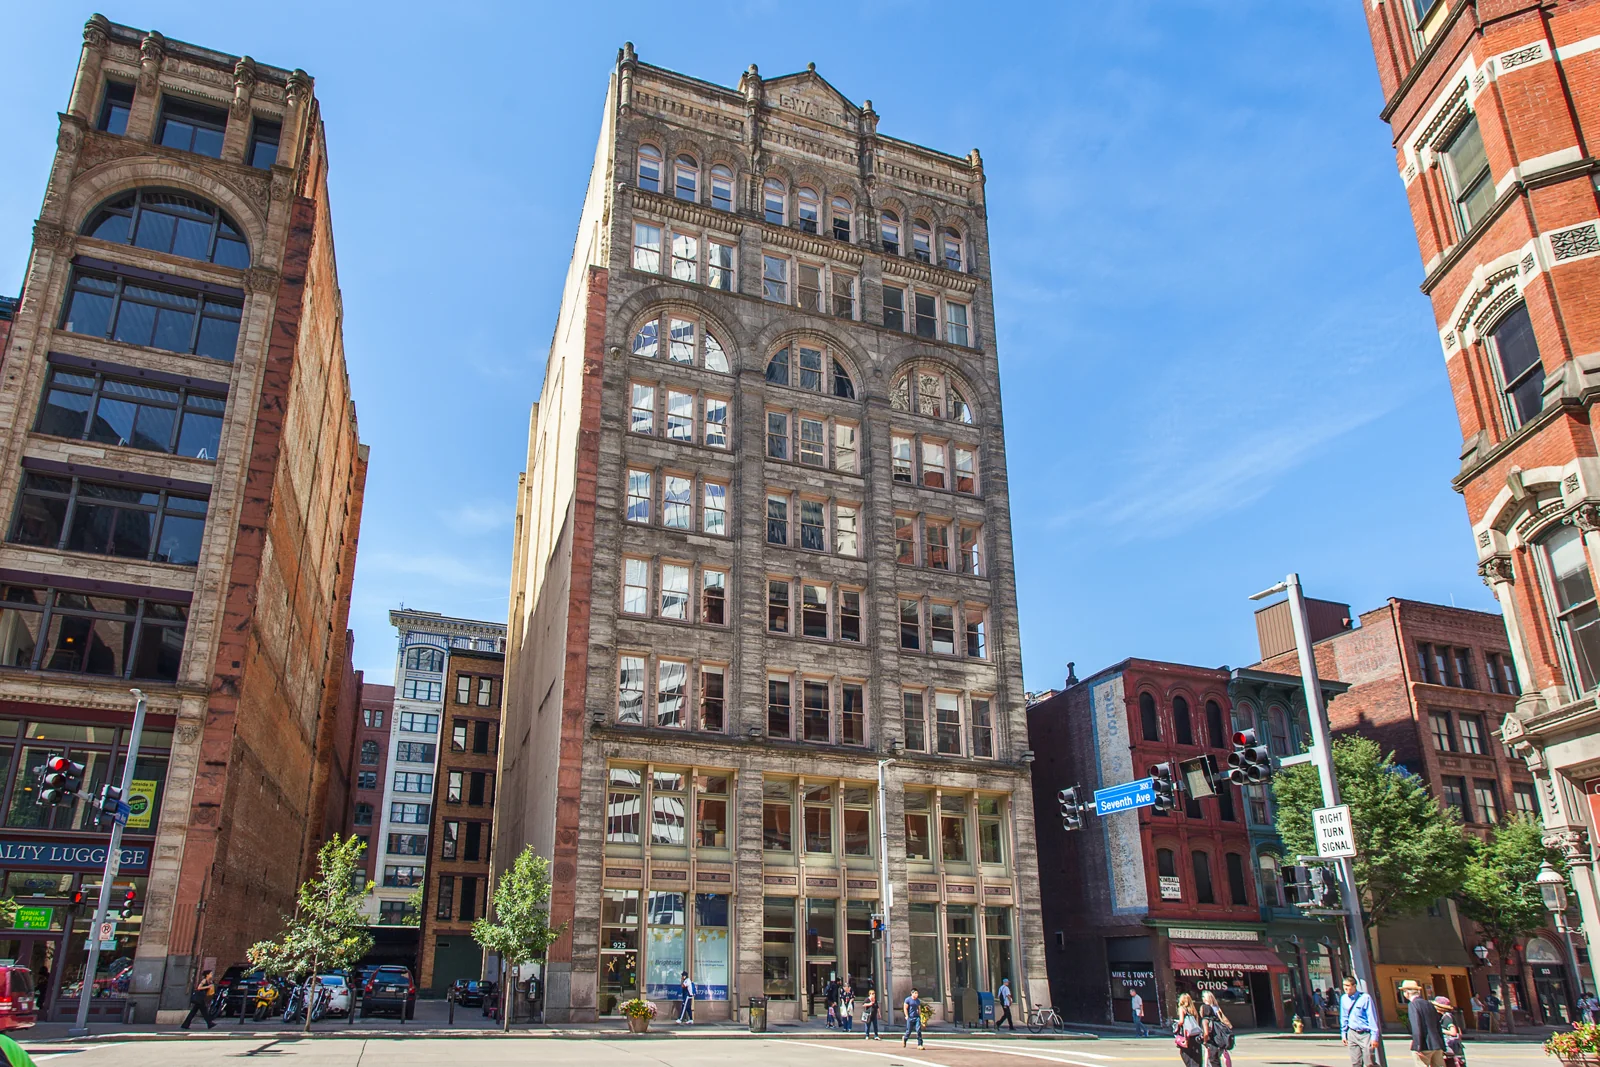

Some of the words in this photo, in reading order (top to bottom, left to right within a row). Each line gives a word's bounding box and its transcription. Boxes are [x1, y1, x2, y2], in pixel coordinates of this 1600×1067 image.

[1139, 782, 1149, 791] 300
[1101, 795, 1133, 811] Seventh
[1135, 792, 1151, 803] Ave
[1319, 811, 1342, 824] RIGHT
[1322, 826, 1344, 838] TURN
[1322, 840, 1351, 853] SIGNAL
[49, 846, 145, 865] LUGGGE
[1133, 971, 1154, 979] TONY'S
[1180, 969, 1204, 977] MIKE
[1213, 970, 1243, 978] TONYS
[1197, 981, 1228, 990] GYROS
